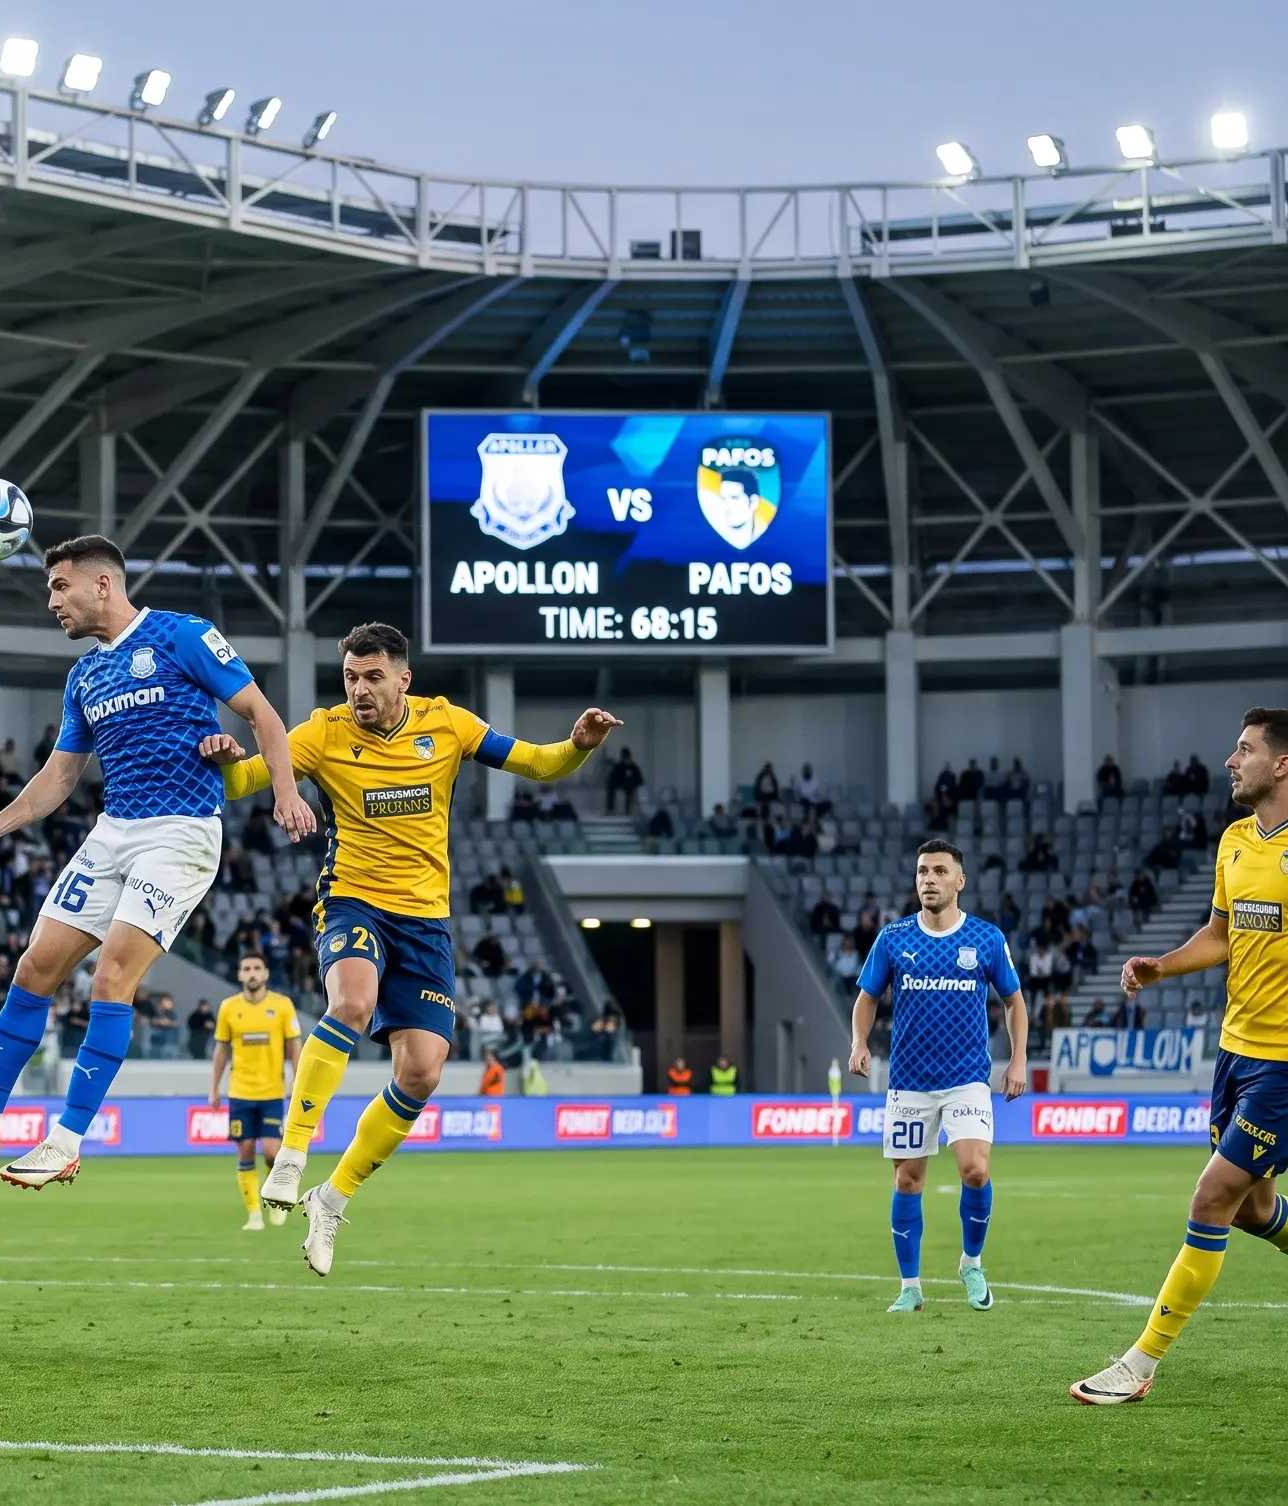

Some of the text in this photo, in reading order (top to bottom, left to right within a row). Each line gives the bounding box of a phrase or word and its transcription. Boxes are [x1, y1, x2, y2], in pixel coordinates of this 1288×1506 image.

[702, 447, 775, 467] PAFOS
[607, 488, 653, 522] VS
[449, 560, 599, 595] APOLLON
[688, 561, 793, 596] PAFOS
[538, 606, 718, 640] TIME: 68:15
[756, 1107, 849, 1134] FONBET
[892, 1121, 924, 1149] 20
[1037, 1106, 1124, 1133] FONBET
